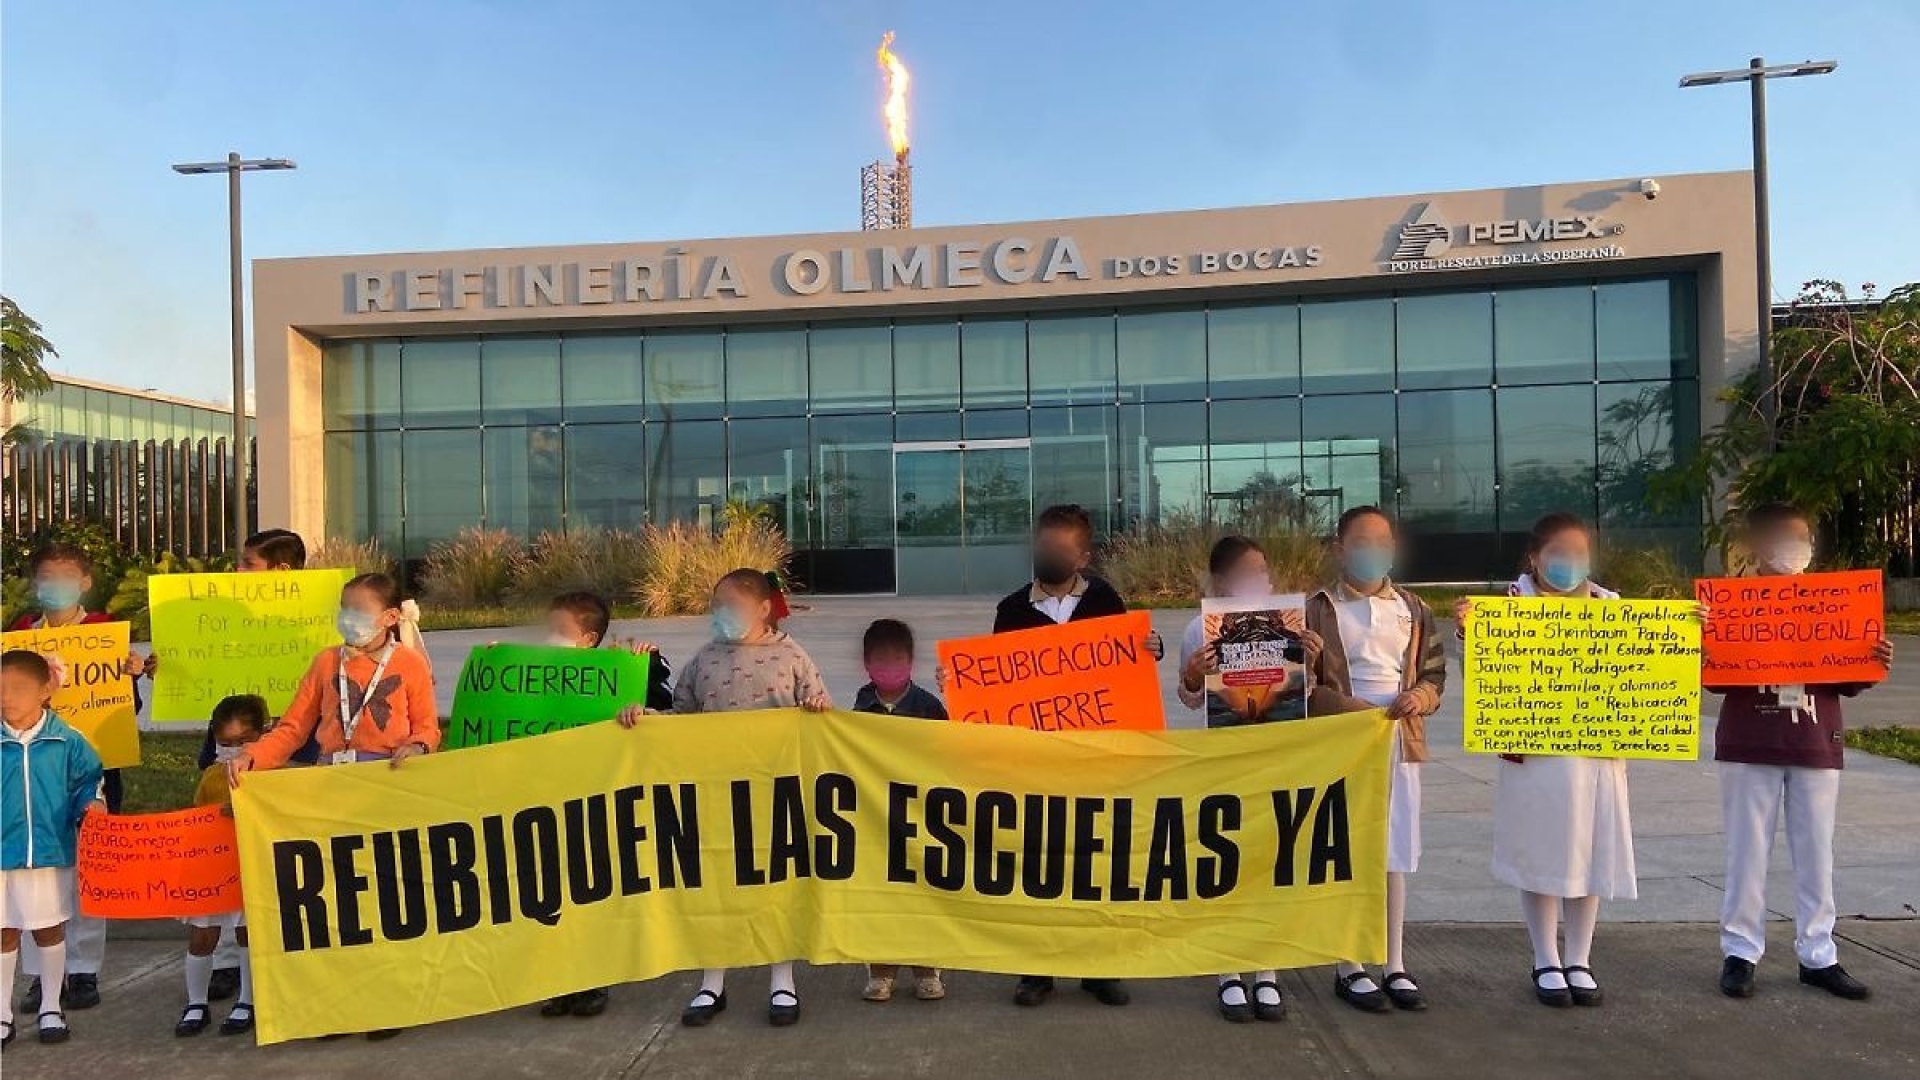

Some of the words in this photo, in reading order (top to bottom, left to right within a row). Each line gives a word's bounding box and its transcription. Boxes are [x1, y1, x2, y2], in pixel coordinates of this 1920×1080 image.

[1468, 216, 1605, 244] PEMEX
[1543, 243, 1625, 262] SOBERANÍA
[354, 248, 748, 313] REFINERÍA
[784, 236, 1092, 296] OLMECA
[1113, 254, 1180, 279] DOS
[1199, 245, 1324, 274] BOCAS
[188, 578, 219, 600] LA
[232, 580, 302, 602] LUCHA
[1699, 581, 1732, 604] No
[1741, 588, 1771, 602] me
[1778, 583, 1850, 601] cierren
[1858, 582, 1879, 593] mi
[1503, 600, 1571, 620] Presidente
[1578, 604, 1594, 620] de
[1602, 605, 1616, 622] la
[1792, 601, 1849, 615] mejor
[277, 611, 334, 629] estanci
[1474, 620, 1536, 638] Claudia
[1543, 621, 1628, 640] Sheinbaum
[1495, 641, 1579, 660] Gobernador
[1587, 641, 1609, 655] del
[1616, 642, 1655, 656] Estado
[951, 634, 1137, 690] REUBICACIÓN
[1473, 657, 1521, 673] Javier
[1530, 660, 1562, 678] May
[464, 658, 496, 692] NO
[500, 665, 619, 697] CIERREN
[1473, 678, 1520, 695] Padres
[1527, 679, 1543, 694] de
[1620, 679, 1677, 691] alumnos
[81, 691, 132, 709] alumnos
[1575, 697, 1590, 710] la
[1008, 689, 1117, 731] CIERRE
[1476, 711, 1492, 726] de
[1499, 712, 1561, 726] nuestras
[1494, 729, 1514, 737] con
[1518, 726, 1573, 739] nuestras
[1578, 725, 1622, 738] clases
[1628, 725, 1643, 736] de
[1551, 738, 1602, 752] nuestros
[1611, 738, 1670, 753] Derechos
[156, 814, 216, 831] nuestro
[136, 836, 180, 848] mejor
[213, 844, 230, 854] de
[272, 783, 702, 953] REUBIQUEN
[730, 772, 858, 887] LAS
[887, 781, 1242, 902] ESCUELAS
[1272, 776, 1353, 887] YA
